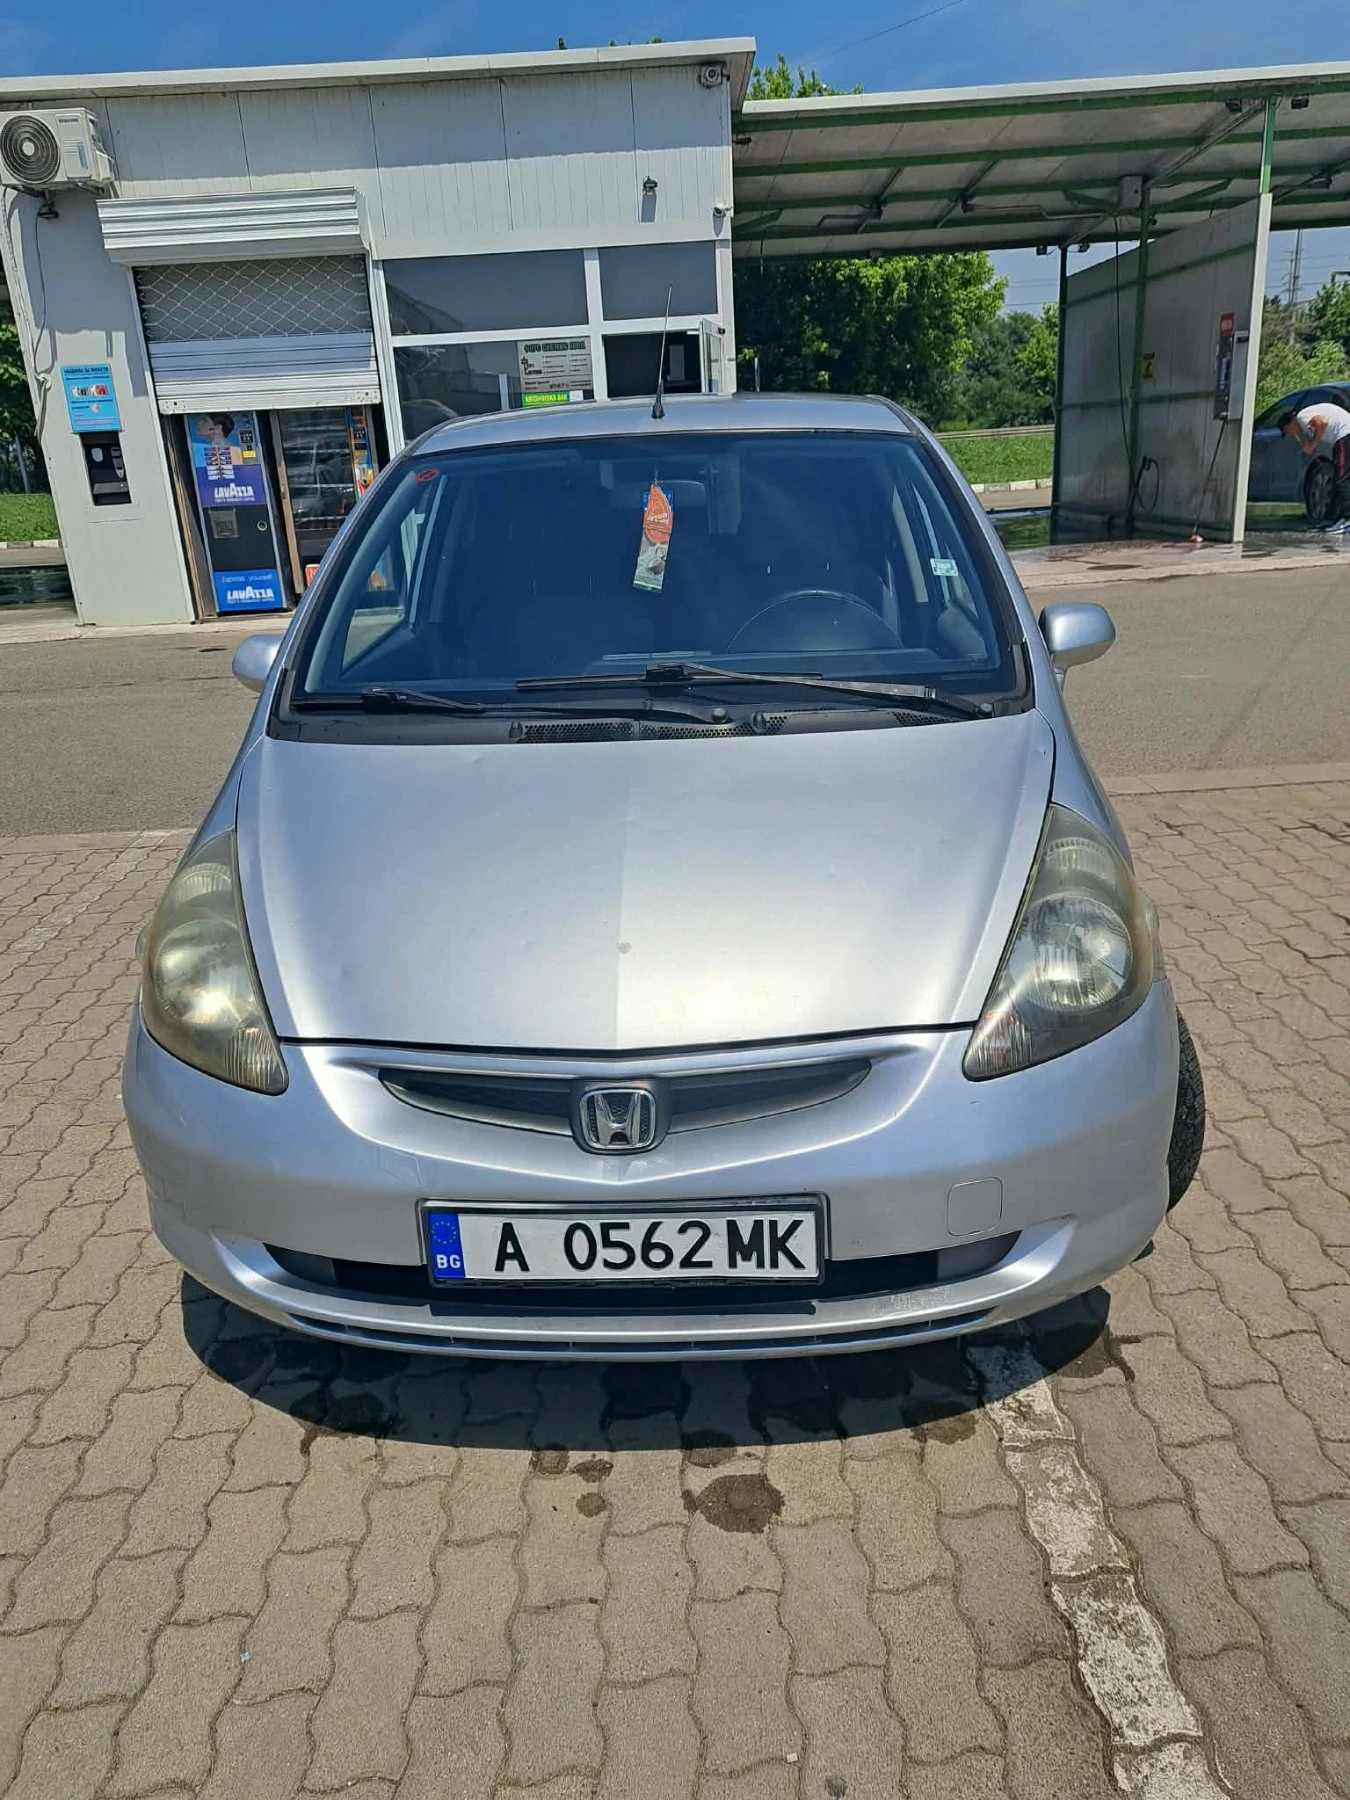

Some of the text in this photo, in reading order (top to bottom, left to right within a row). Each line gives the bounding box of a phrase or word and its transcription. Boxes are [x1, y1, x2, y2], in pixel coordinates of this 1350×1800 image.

[214, 482, 254, 498] LAVAZZA
[227, 586, 275, 600] LAVAZZA
[494, 1219, 807, 1272] A 0562 MK
[436, 1254, 461, 1268] BG
